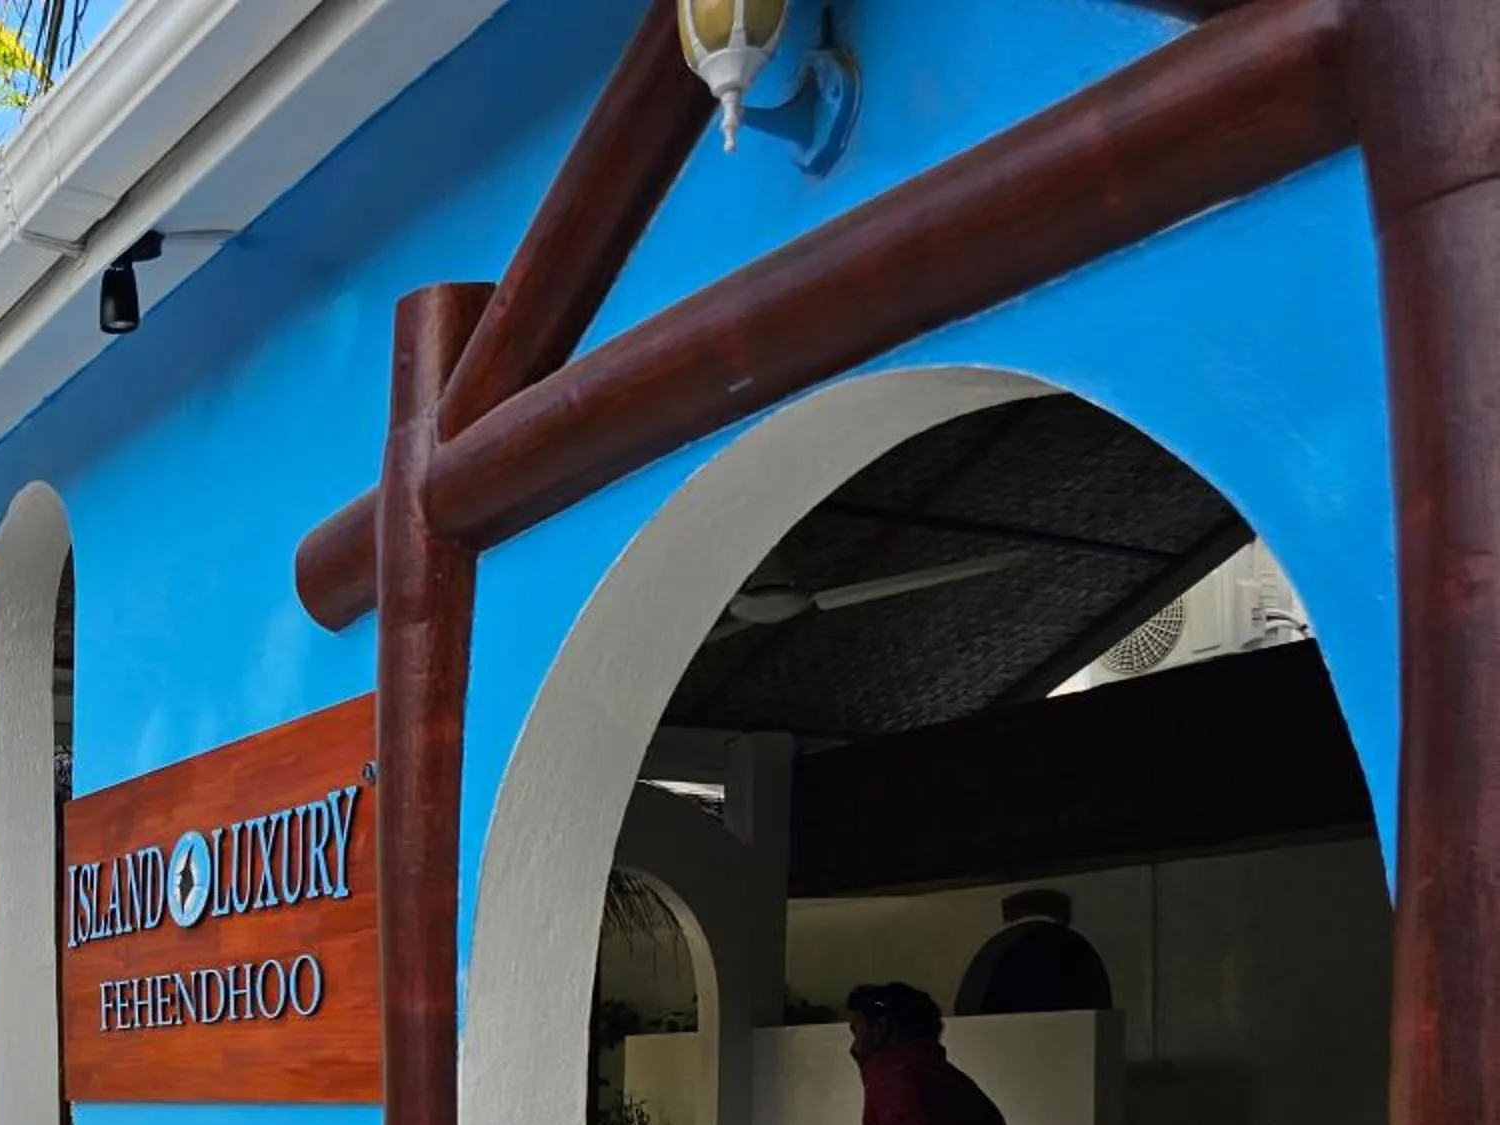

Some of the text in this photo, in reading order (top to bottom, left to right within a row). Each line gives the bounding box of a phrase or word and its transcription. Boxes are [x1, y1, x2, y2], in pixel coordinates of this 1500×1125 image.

[68, 785, 358, 948] ISLAND LUXURY
[100, 953, 323, 1032] FEHENDHOO
